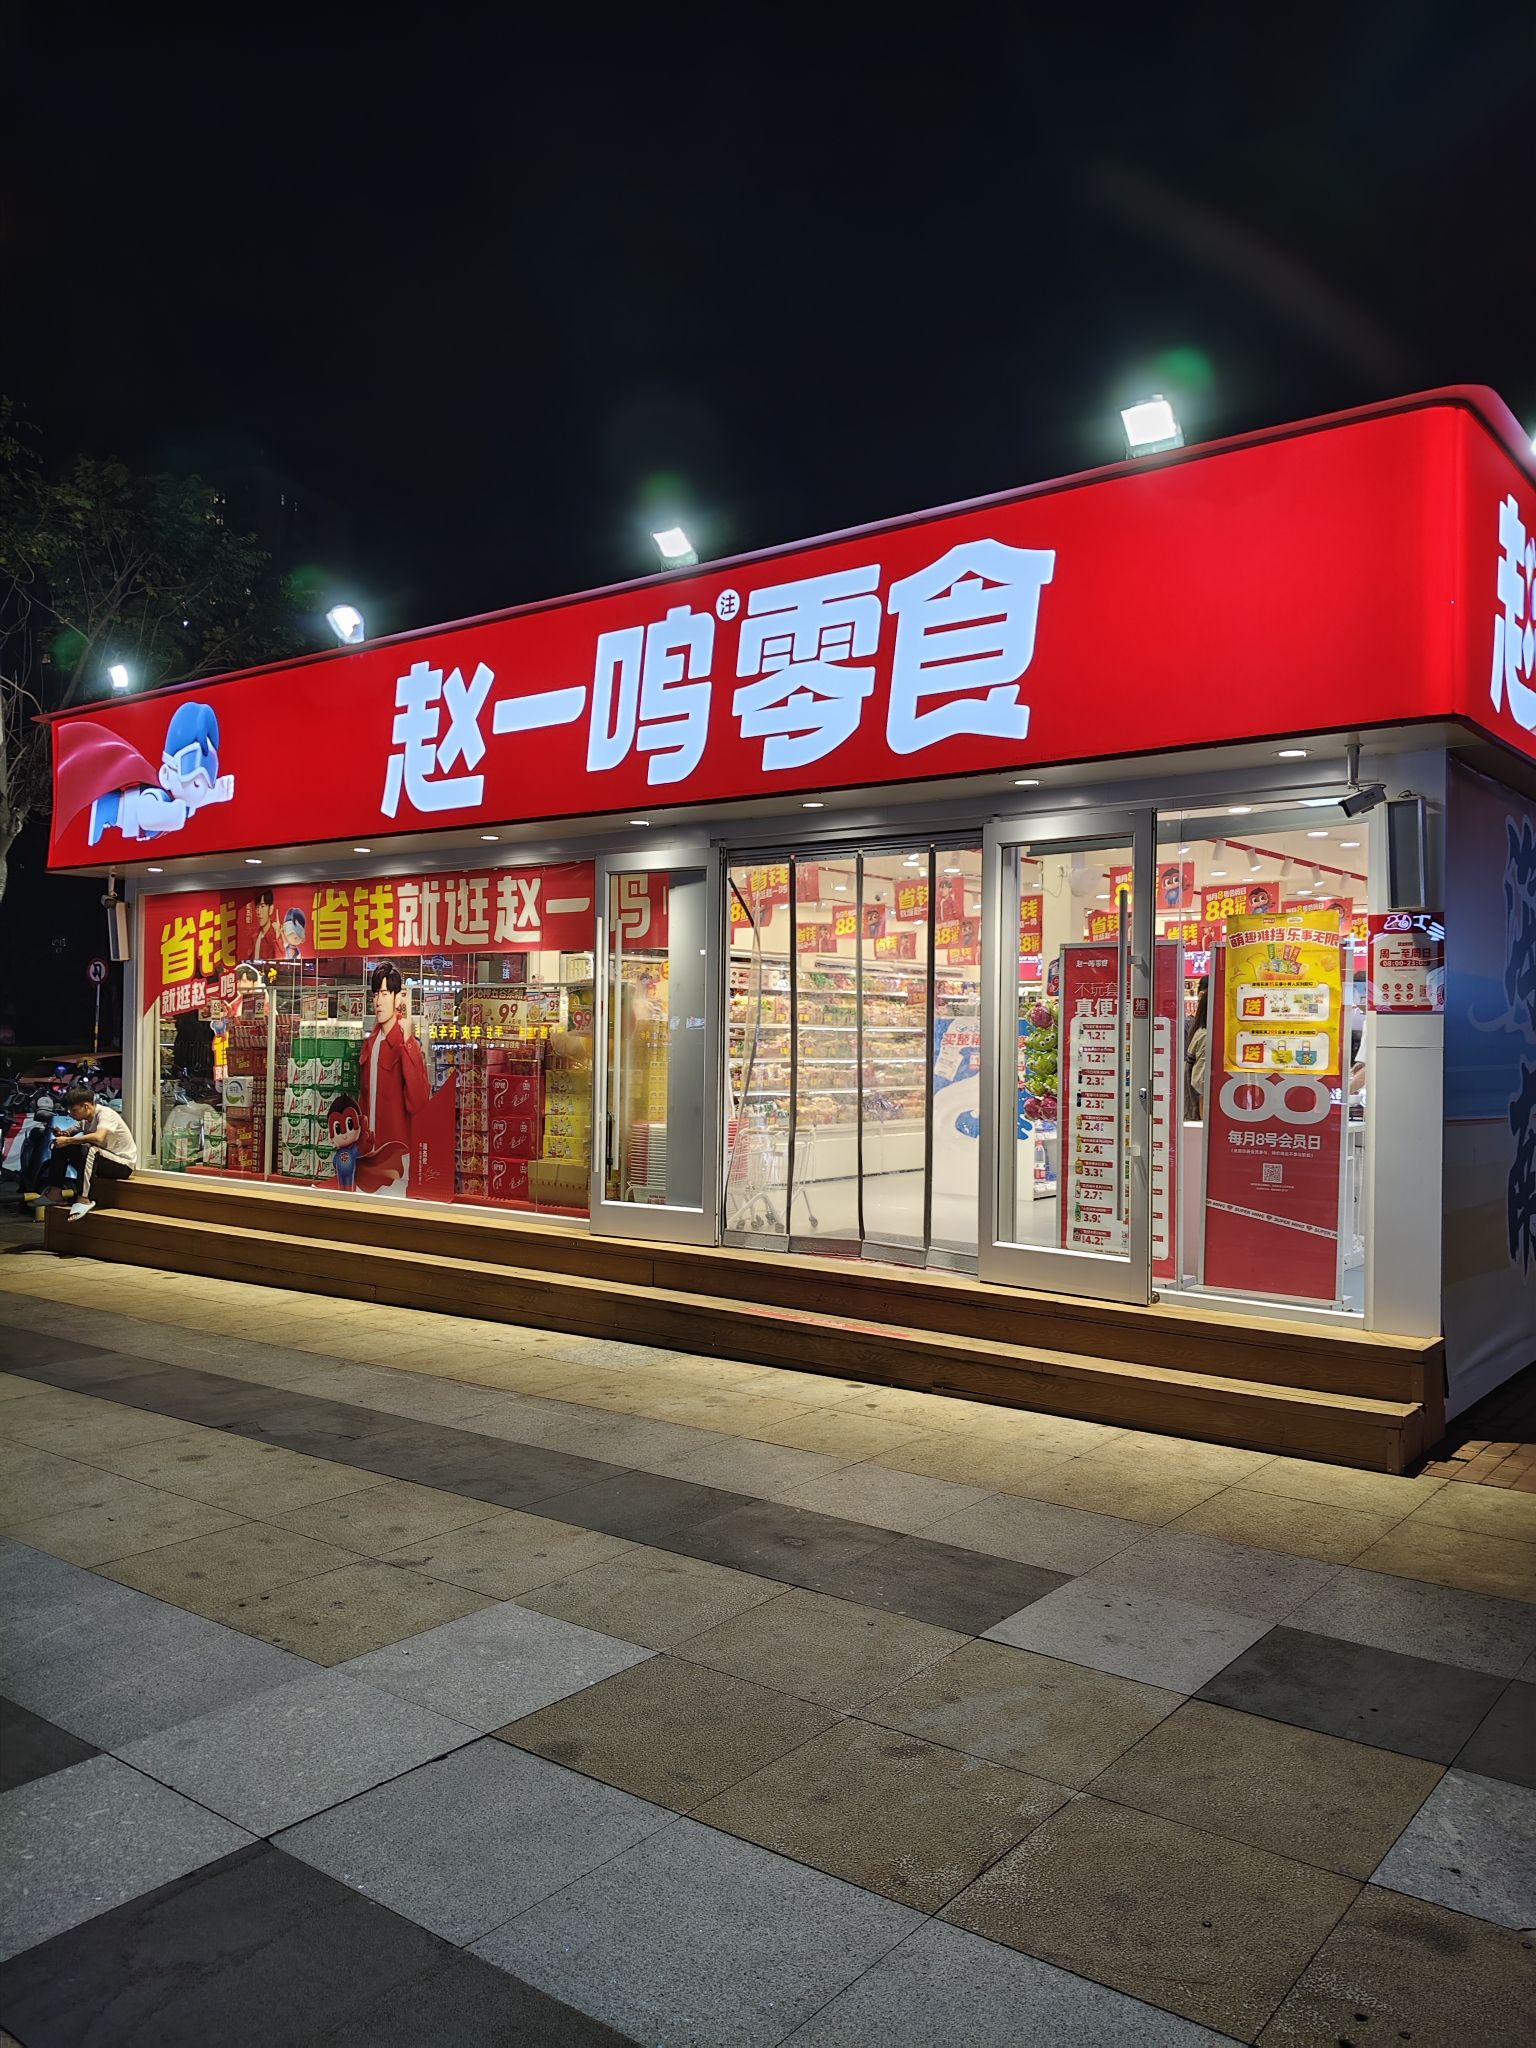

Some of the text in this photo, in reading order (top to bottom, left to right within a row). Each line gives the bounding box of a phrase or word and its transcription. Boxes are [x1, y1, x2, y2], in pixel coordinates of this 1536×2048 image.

[720, 594, 736, 615] 注
[381, 538, 1057, 819] 赵一鸣零食
[161, 901, 237, 985] 省钱
[1230, 928, 1340, 948] 萌趣难挡 乐事无限
[1380, 948, 1431, 959] 周一至周日
[1382, 960, 1429, 968] 08:00-23:00
[161, 973, 236, 1015] 就逛赵一鸣
[1135, 1000, 1147, 1011] 推
[1244, 999, 1261, 1015] 送
[1244, 1046, 1260, 1061] 送
[1228, 1130, 1321, 1150] 每月8号会员日
